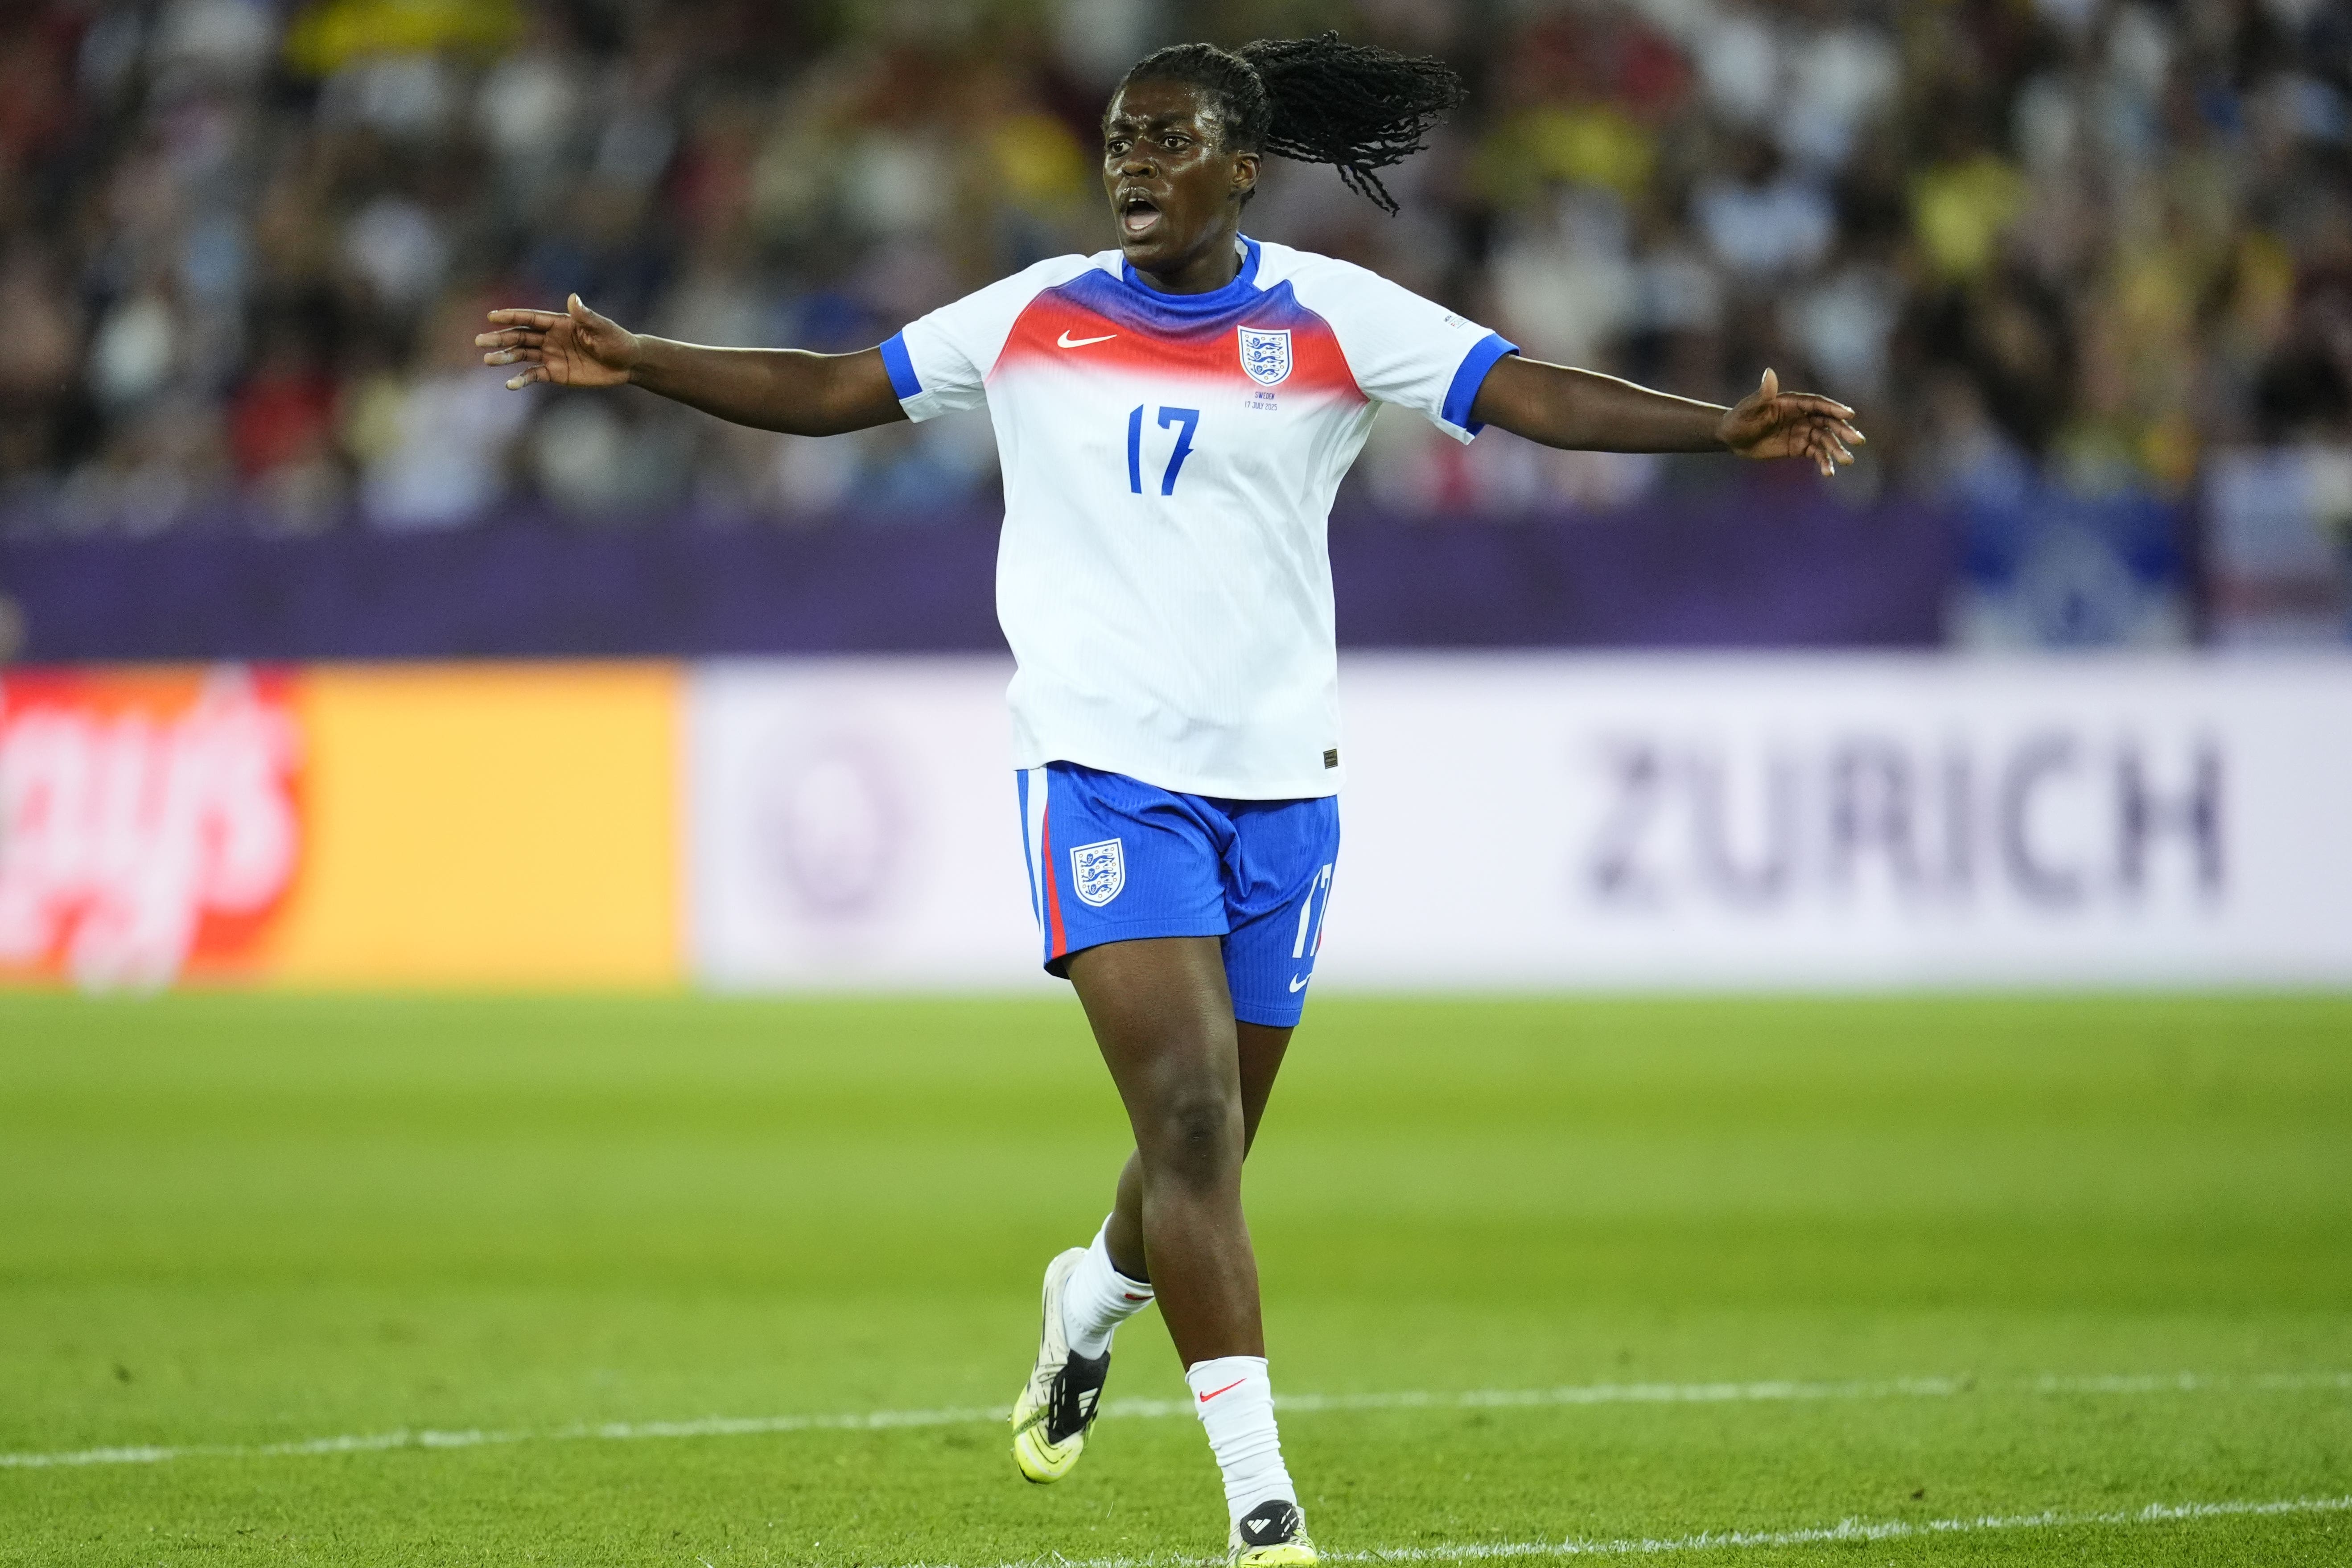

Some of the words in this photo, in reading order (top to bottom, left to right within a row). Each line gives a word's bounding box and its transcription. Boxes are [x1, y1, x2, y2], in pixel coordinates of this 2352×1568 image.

[1255, 391, 1275, 400] SWEDEN
[1128, 403, 1199, 495] 17
[1583, 731, 2226, 914] ZURICH
[1292, 862, 1332, 958] 17
